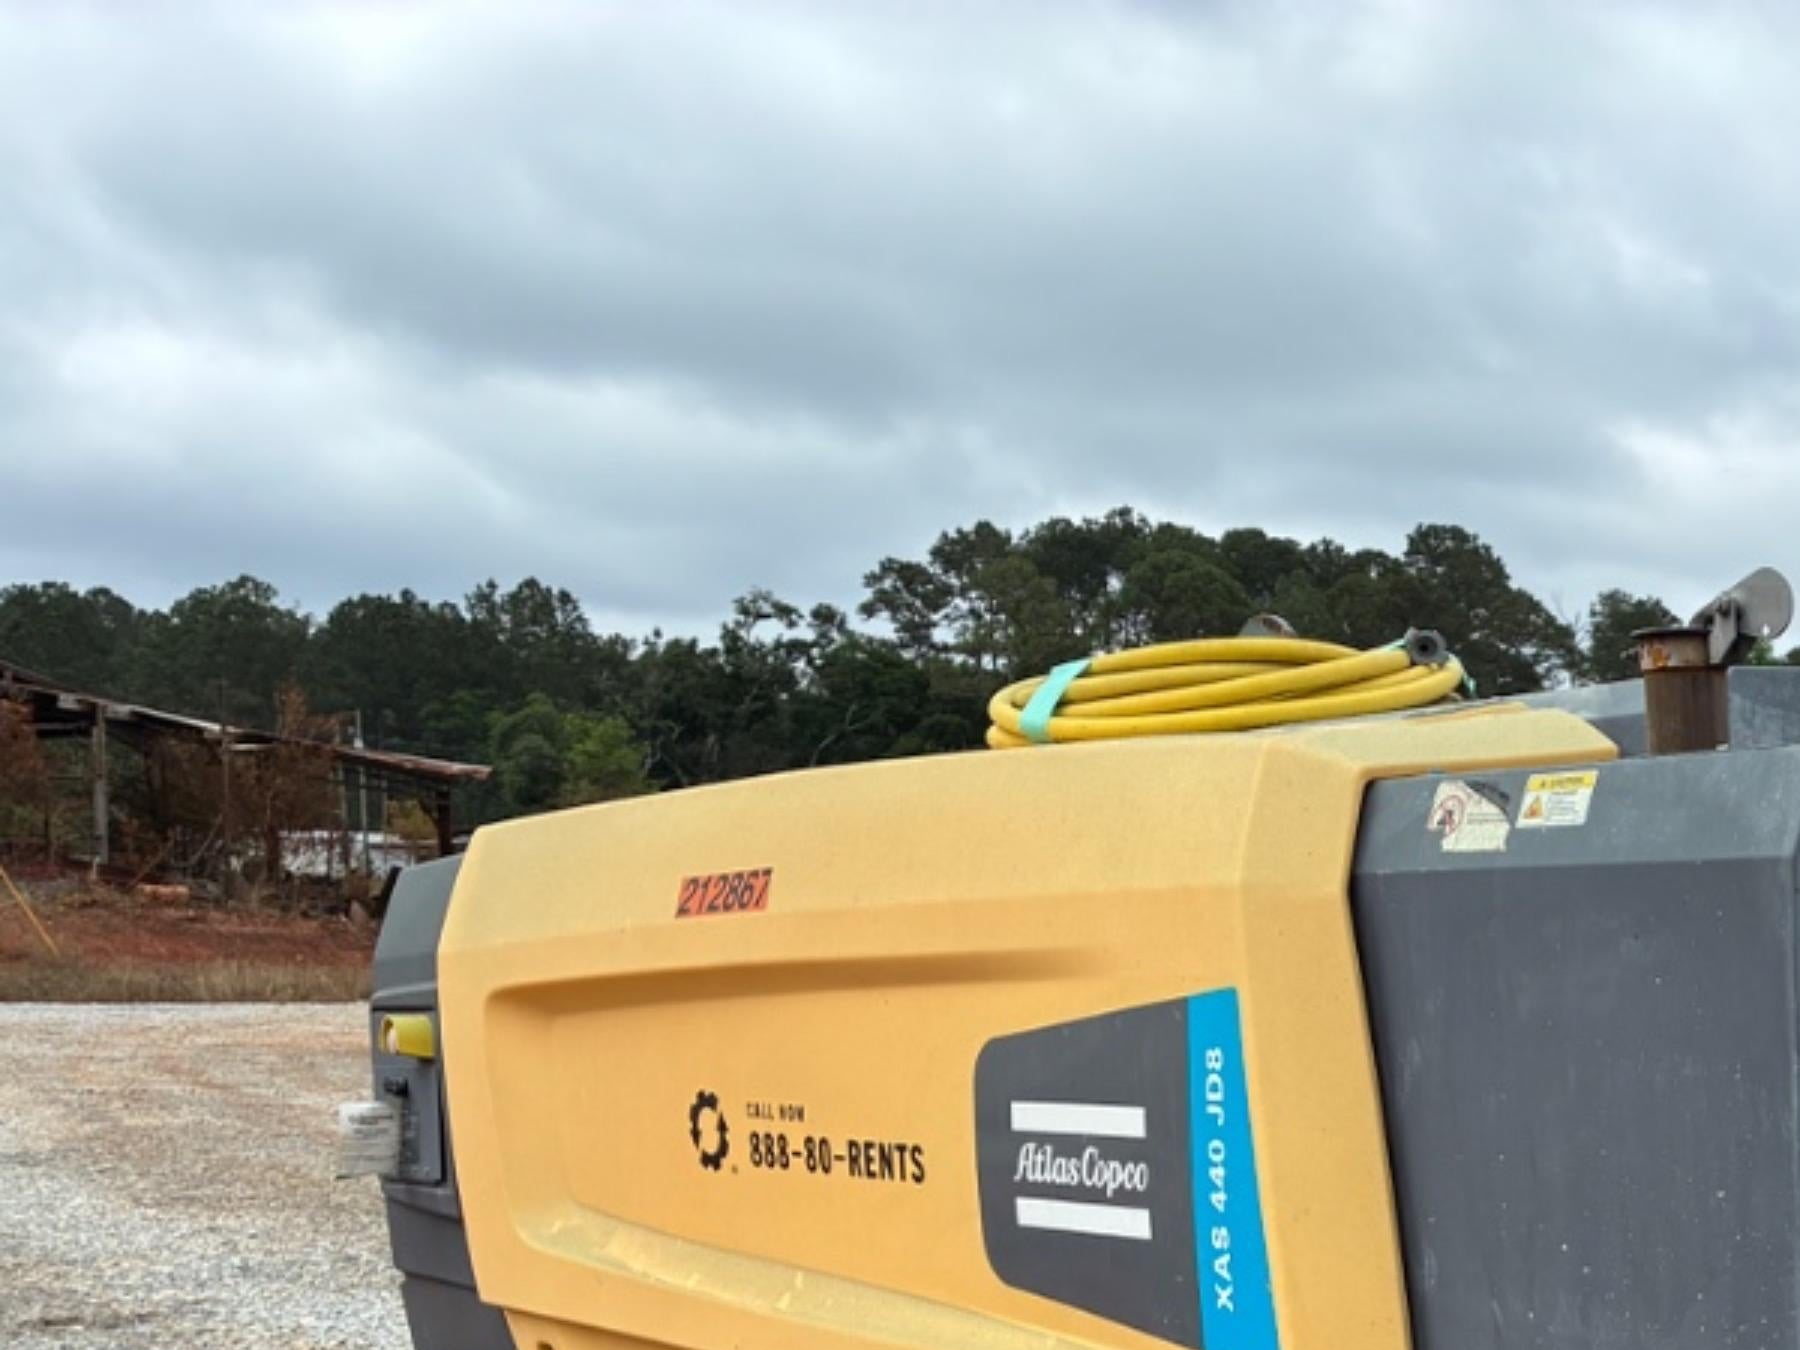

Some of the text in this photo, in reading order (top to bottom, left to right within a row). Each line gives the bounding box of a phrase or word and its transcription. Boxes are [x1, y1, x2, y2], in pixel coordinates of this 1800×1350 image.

[676, 867, 772, 917] 212867
[746, 1103, 805, 1122] CALL NOW
[750, 1131, 925, 1184] 888-80-RENTS
[1205, 1047, 1234, 1312] XAS 440 JD8
